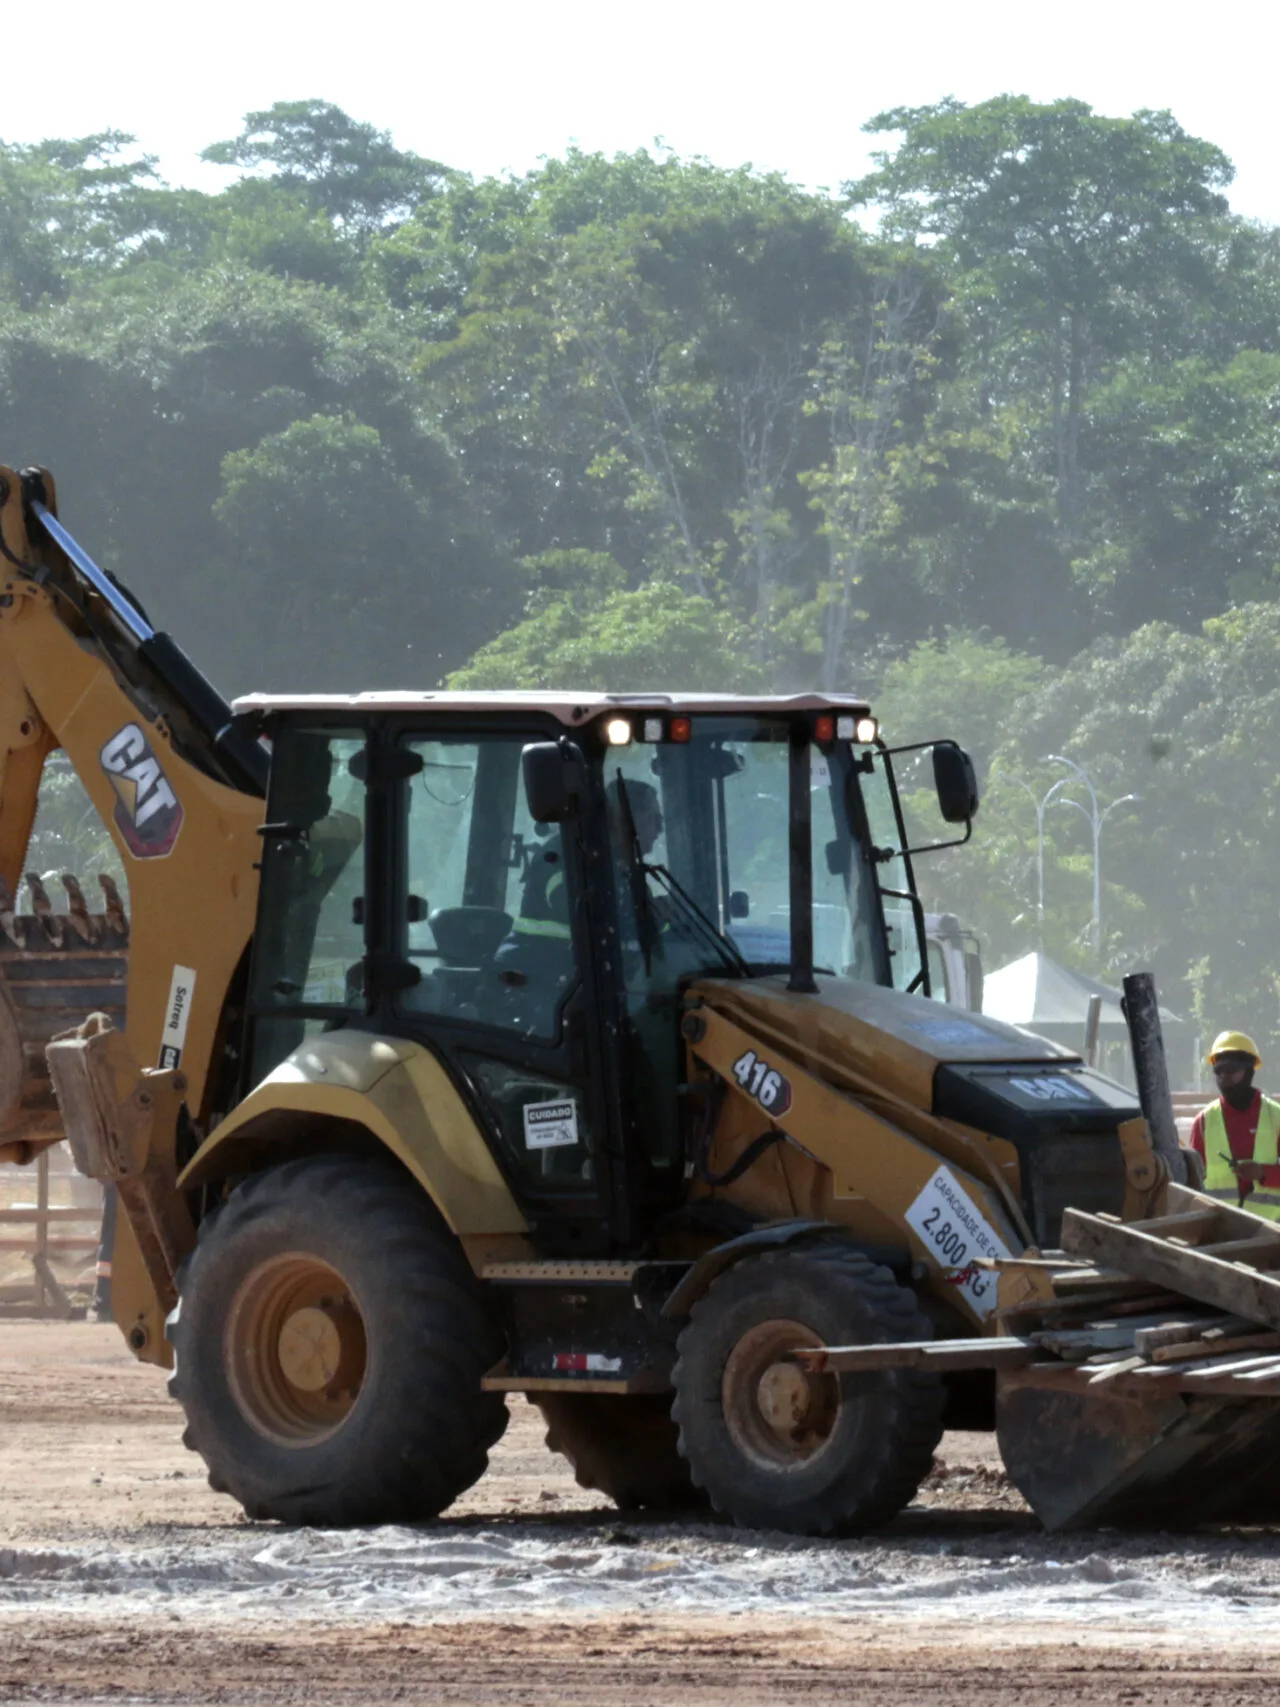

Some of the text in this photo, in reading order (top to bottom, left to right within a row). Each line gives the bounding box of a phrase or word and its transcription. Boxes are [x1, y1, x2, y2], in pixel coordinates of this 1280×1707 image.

[100, 723, 177, 828] CAT
[168, 985, 187, 1030] Sotreq
[733, 1050, 782, 1107] 416
[1009, 1077, 1091, 1100] CAT
[528, 1107, 571, 1121] CUIDADO
[921, 1206, 967, 1266] 2.800
[934, 1176, 980, 1238] CAPACIDADE
[975, 1231, 991, 1251] DE
